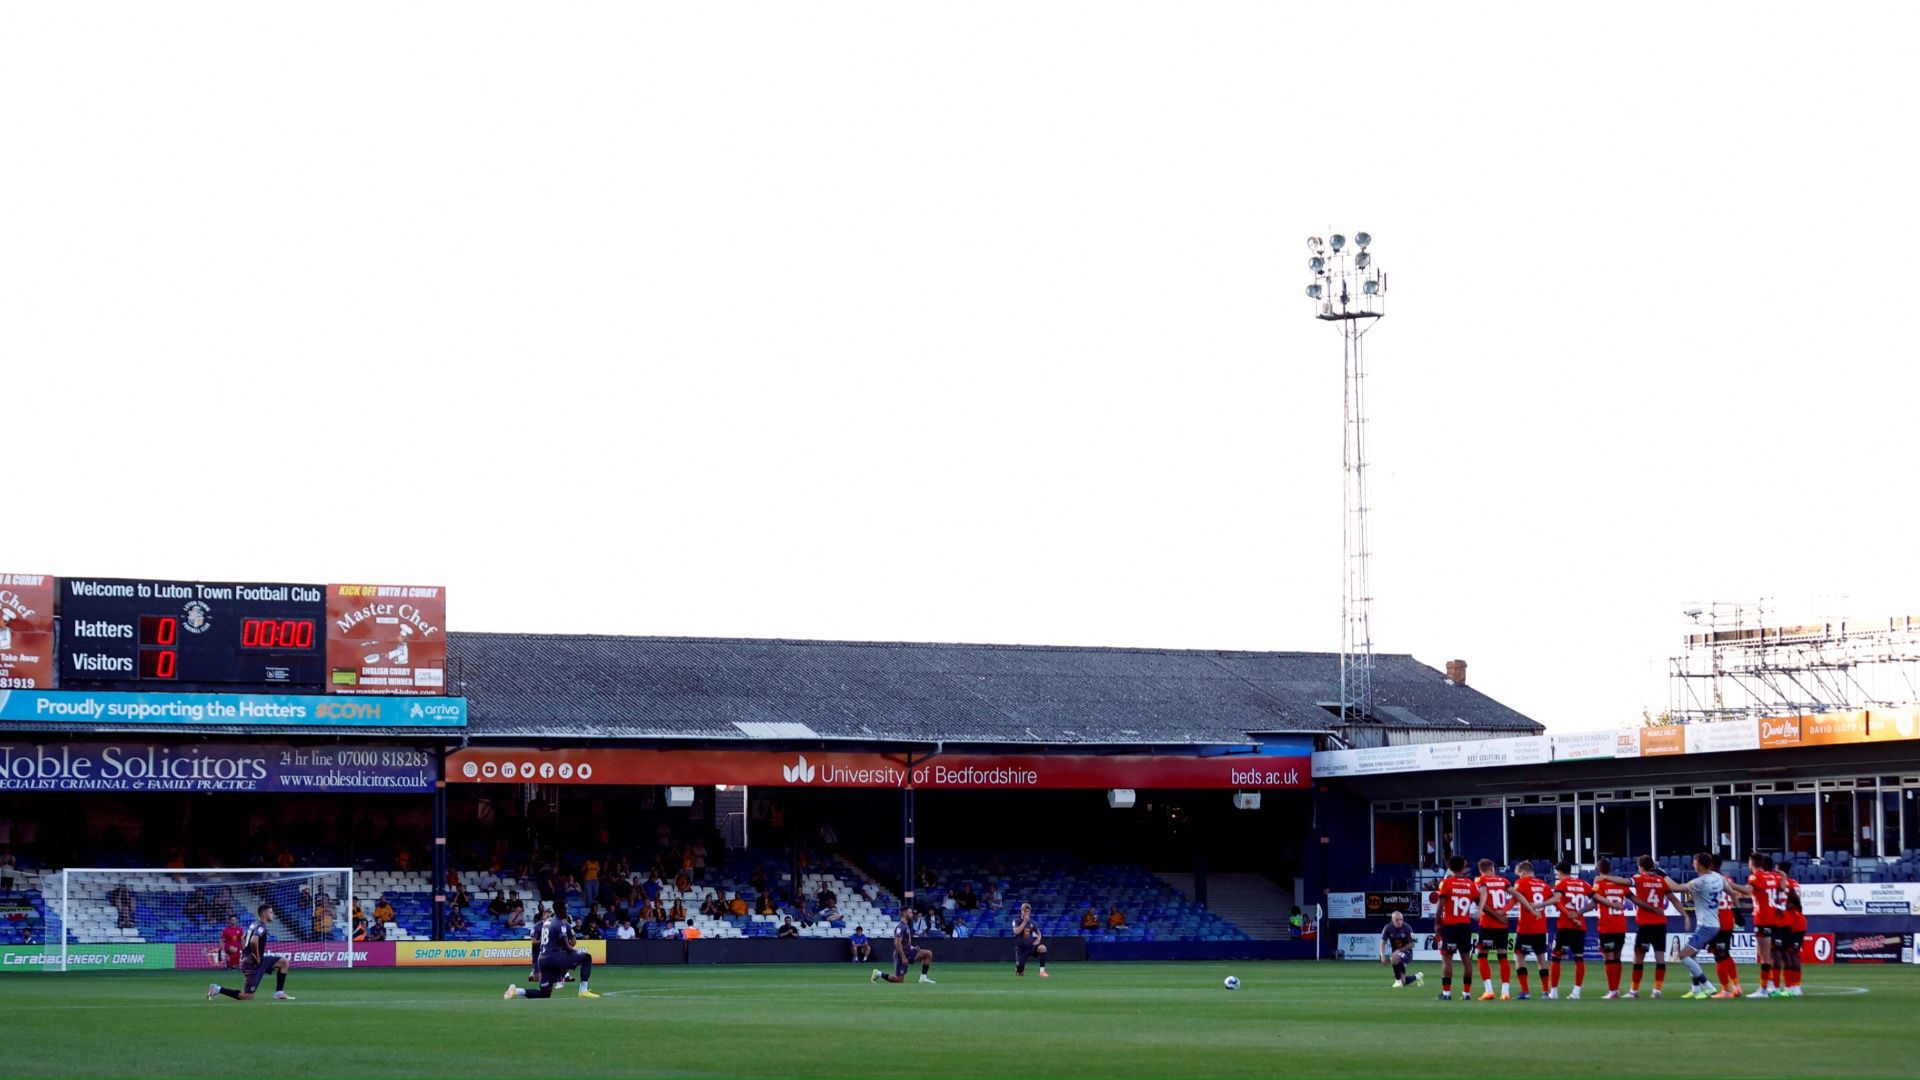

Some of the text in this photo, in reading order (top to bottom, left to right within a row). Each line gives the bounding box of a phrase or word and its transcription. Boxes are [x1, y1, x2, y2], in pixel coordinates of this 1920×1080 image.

[12, 576, 44, 586] CURRY
[71, 581, 321, 602] Welcome to Luton Town Football Club
[339, 585, 438, 598] KICK OFF WITH A CURRY
[0, 590, 35, 618] Chef
[336, 602, 438, 637] Master Chef
[74, 620, 133, 638] Hatters
[157, 618, 177, 645] 0
[242, 620, 314, 648] 00:00
[1, 654, 40, 663] Take Away
[72, 653, 133, 671] Visitors
[157, 651, 177, 678] 0
[37, 698, 381, 720] Proudly supporting the Hatters #COYH
[425, 703, 460, 715] arriva
[1809, 724, 1833, 735] DAVID
[101, 746, 267, 779] Solicitors
[280, 751, 429, 767] 24 hr line 07000 818283
[60, 779, 129, 789] CRIMINAL
[133, 779, 145, 789] &
[148, 779, 197, 789] FAMILY
[197, 780, 256, 790] PRACTICE
[280, 770, 428, 787] www.noblesolicitors.co.uk
[821, 765, 1037, 786] University of Bedfordshire
[1231, 768, 1299, 785] beds.ac.uk
[1451, 896, 1471, 916] 19
[1489, 889, 1506, 909] 10
[1647, 889, 1659, 907] 4
[66, 954, 110, 964] ENERGY
[112, 954, 145, 964] DRINK
[294, 951, 335, 962] ENERGY
[415, 949, 441, 959] SHOP
[444, 949, 468, 958] NOW
[469, 949, 481, 958] AT
